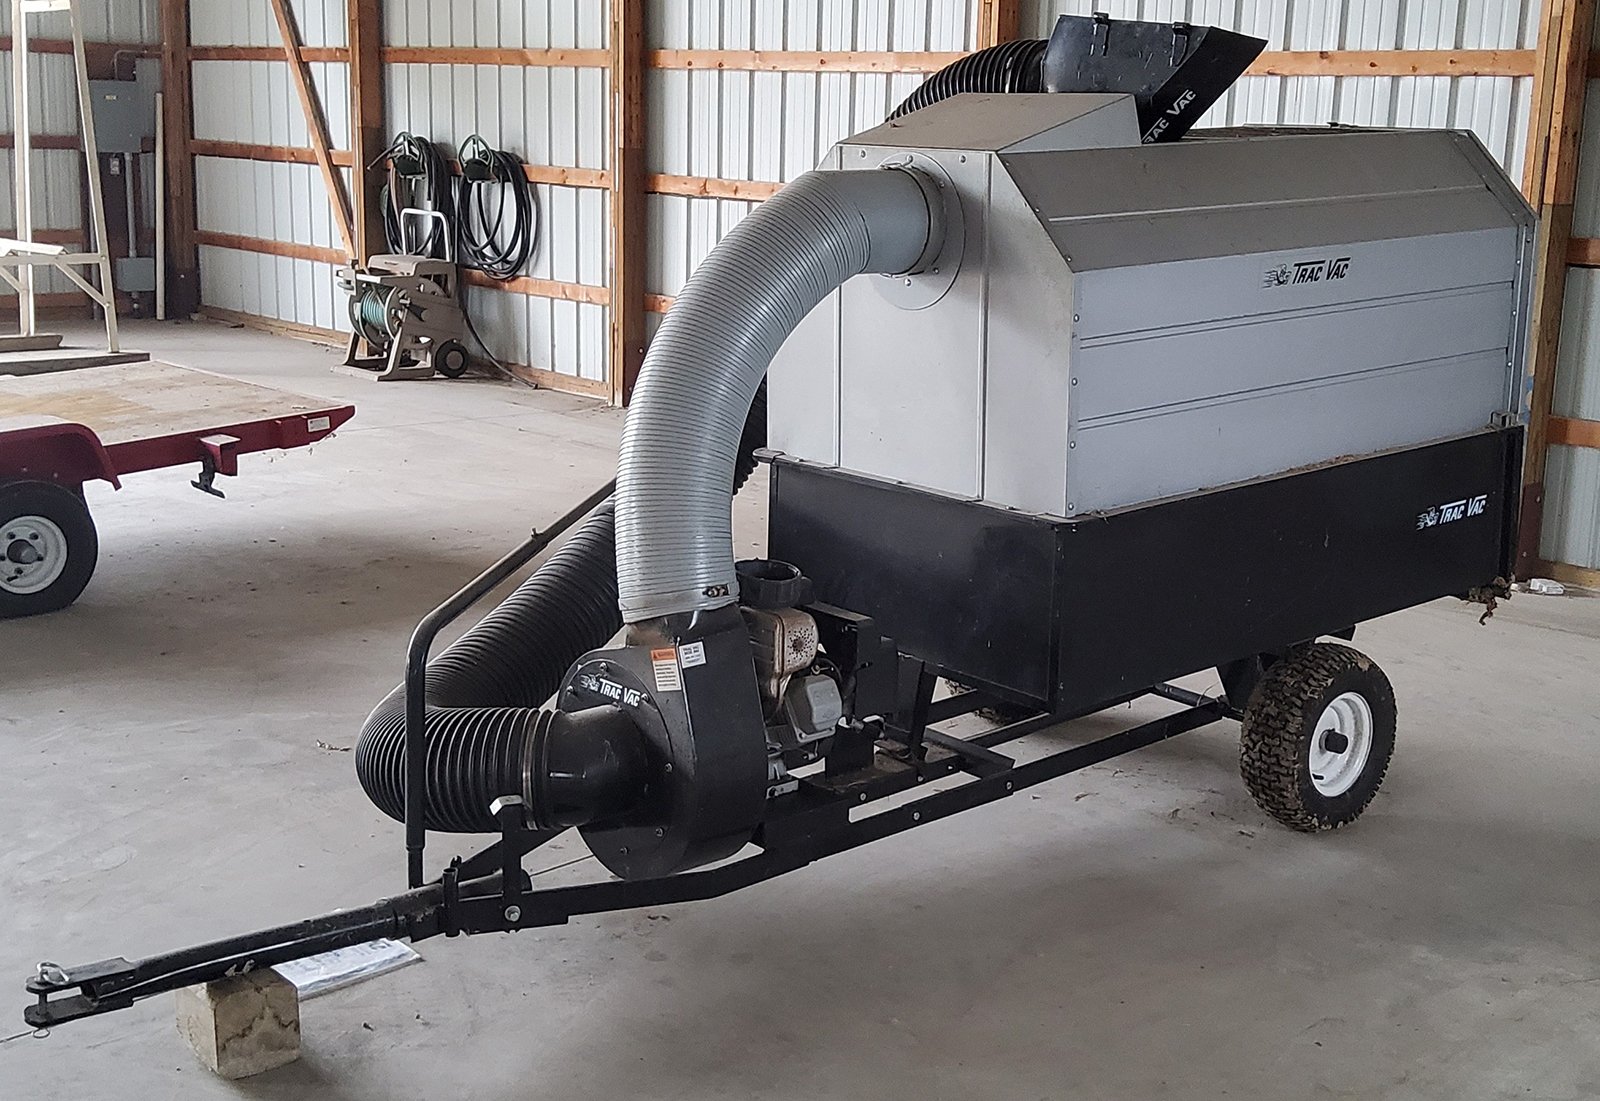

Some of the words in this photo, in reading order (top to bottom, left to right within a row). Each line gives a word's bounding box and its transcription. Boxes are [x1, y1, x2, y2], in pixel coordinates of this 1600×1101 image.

[1141, 117, 1169, 143] RAC
[1166, 89, 1196, 115] VAC
[1292, 260, 1326, 284] TRAC
[1326, 257, 1351, 280] VAC
[1439, 499, 1467, 524] TRAC
[1467, 494, 1488, 517] VAC
[600, 678, 623, 700] TRAC
[623, 687, 641, 707] VAC
